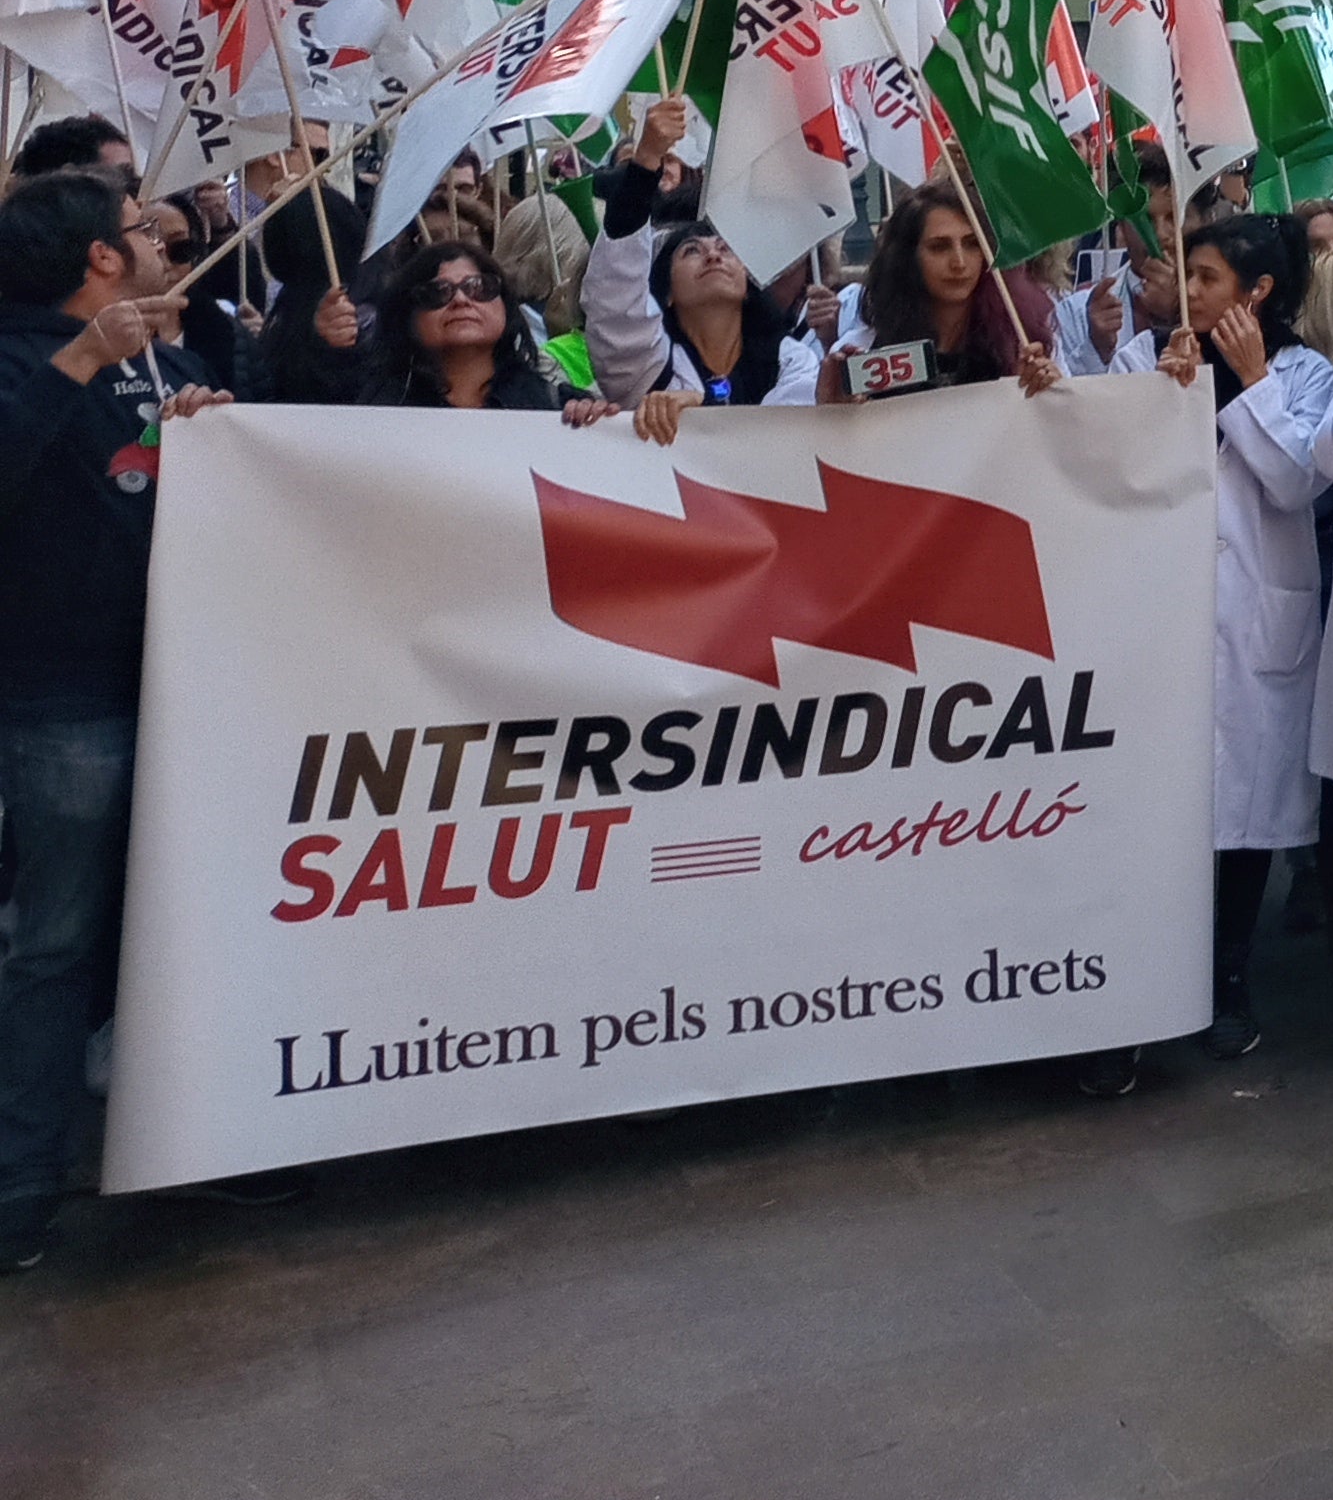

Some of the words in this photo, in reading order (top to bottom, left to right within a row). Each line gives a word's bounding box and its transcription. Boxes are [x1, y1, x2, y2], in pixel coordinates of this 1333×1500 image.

[112, 379, 152, 396] Hello
[861, 352, 914, 391] 35
[287, 669, 1117, 826] INTERSINDICAL
[269, 804, 633, 924] SALUT
[798, 779, 1090, 867] castelló
[274, 1015, 560, 1098] LLuitem
[580, 985, 706, 1069] pels
[726, 957, 945, 1036] nostres
[964, 947, 1108, 1007] drets
